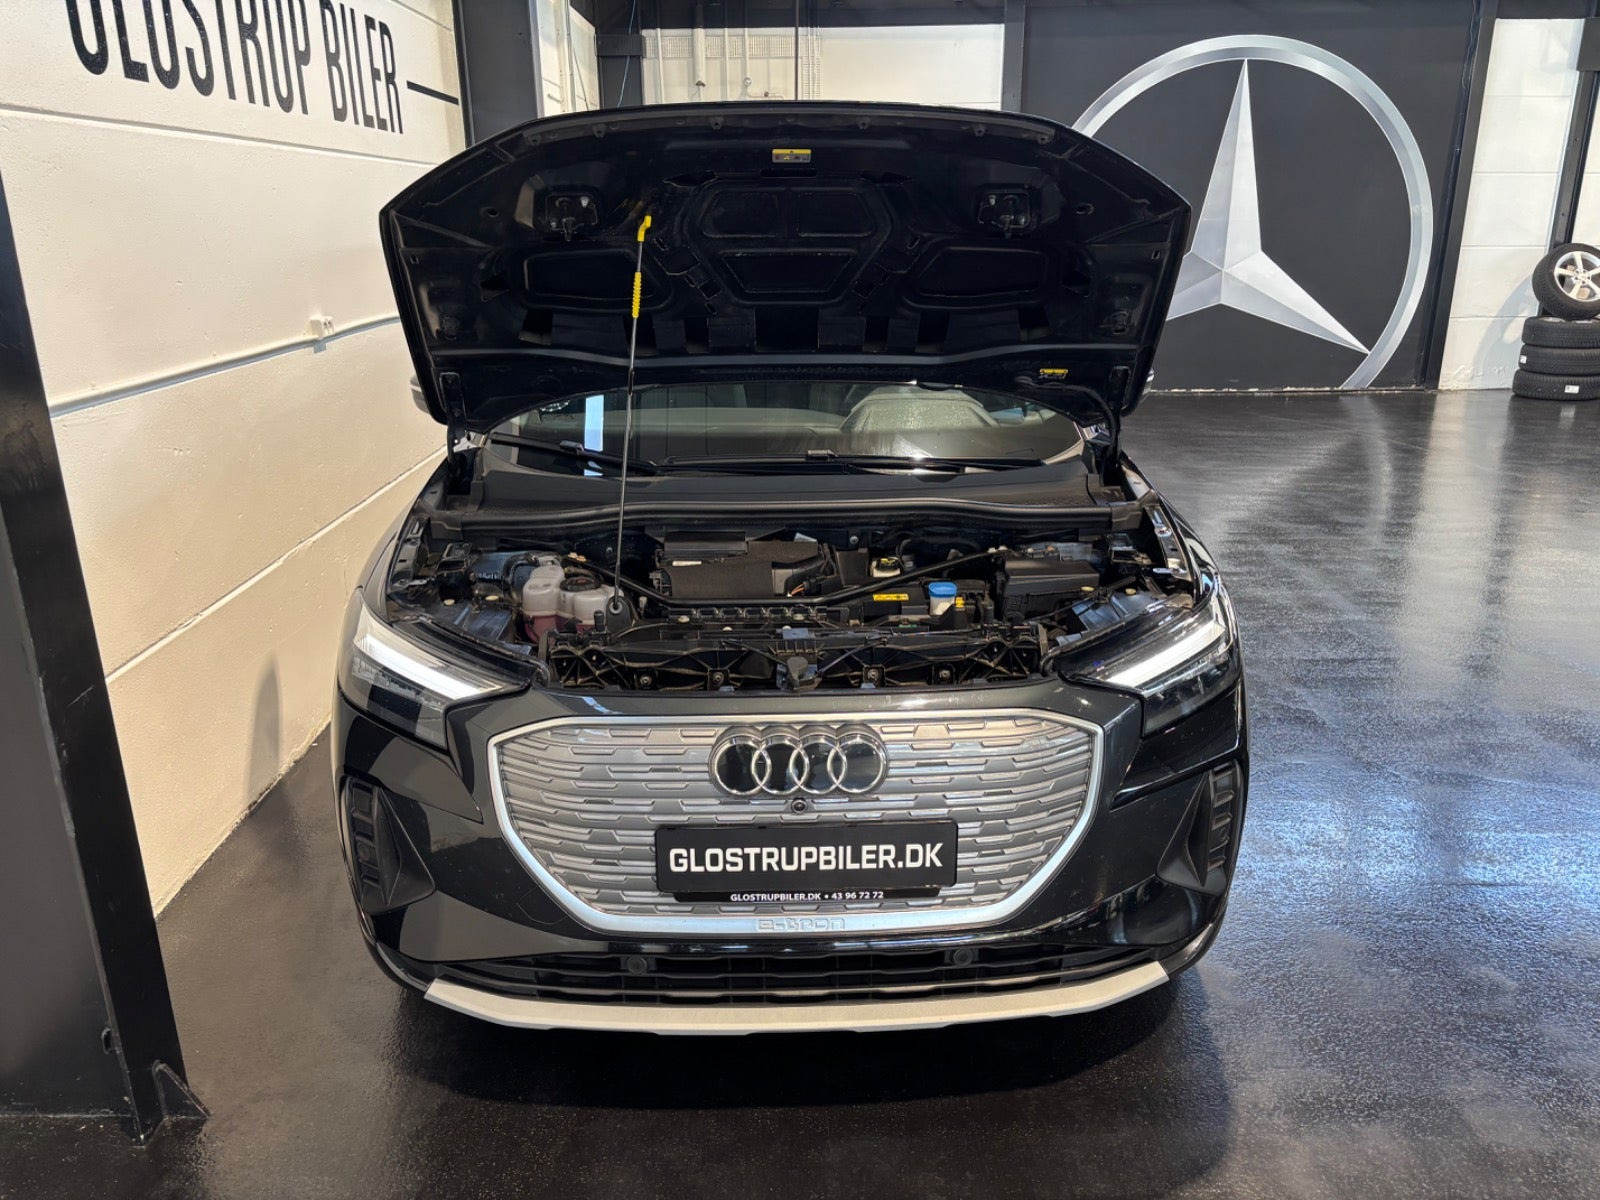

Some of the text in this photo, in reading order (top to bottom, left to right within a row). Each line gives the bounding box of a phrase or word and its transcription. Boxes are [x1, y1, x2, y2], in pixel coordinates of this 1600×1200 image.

[319, 0, 404, 134] BILER
[669, 843, 943, 873] GLOSTRUPBILER.DK
[730, 893, 821, 901] GLOSTRUPBILER.DK
[831, 892, 842, 900] 43
[872, 891, 884, 899] 72
